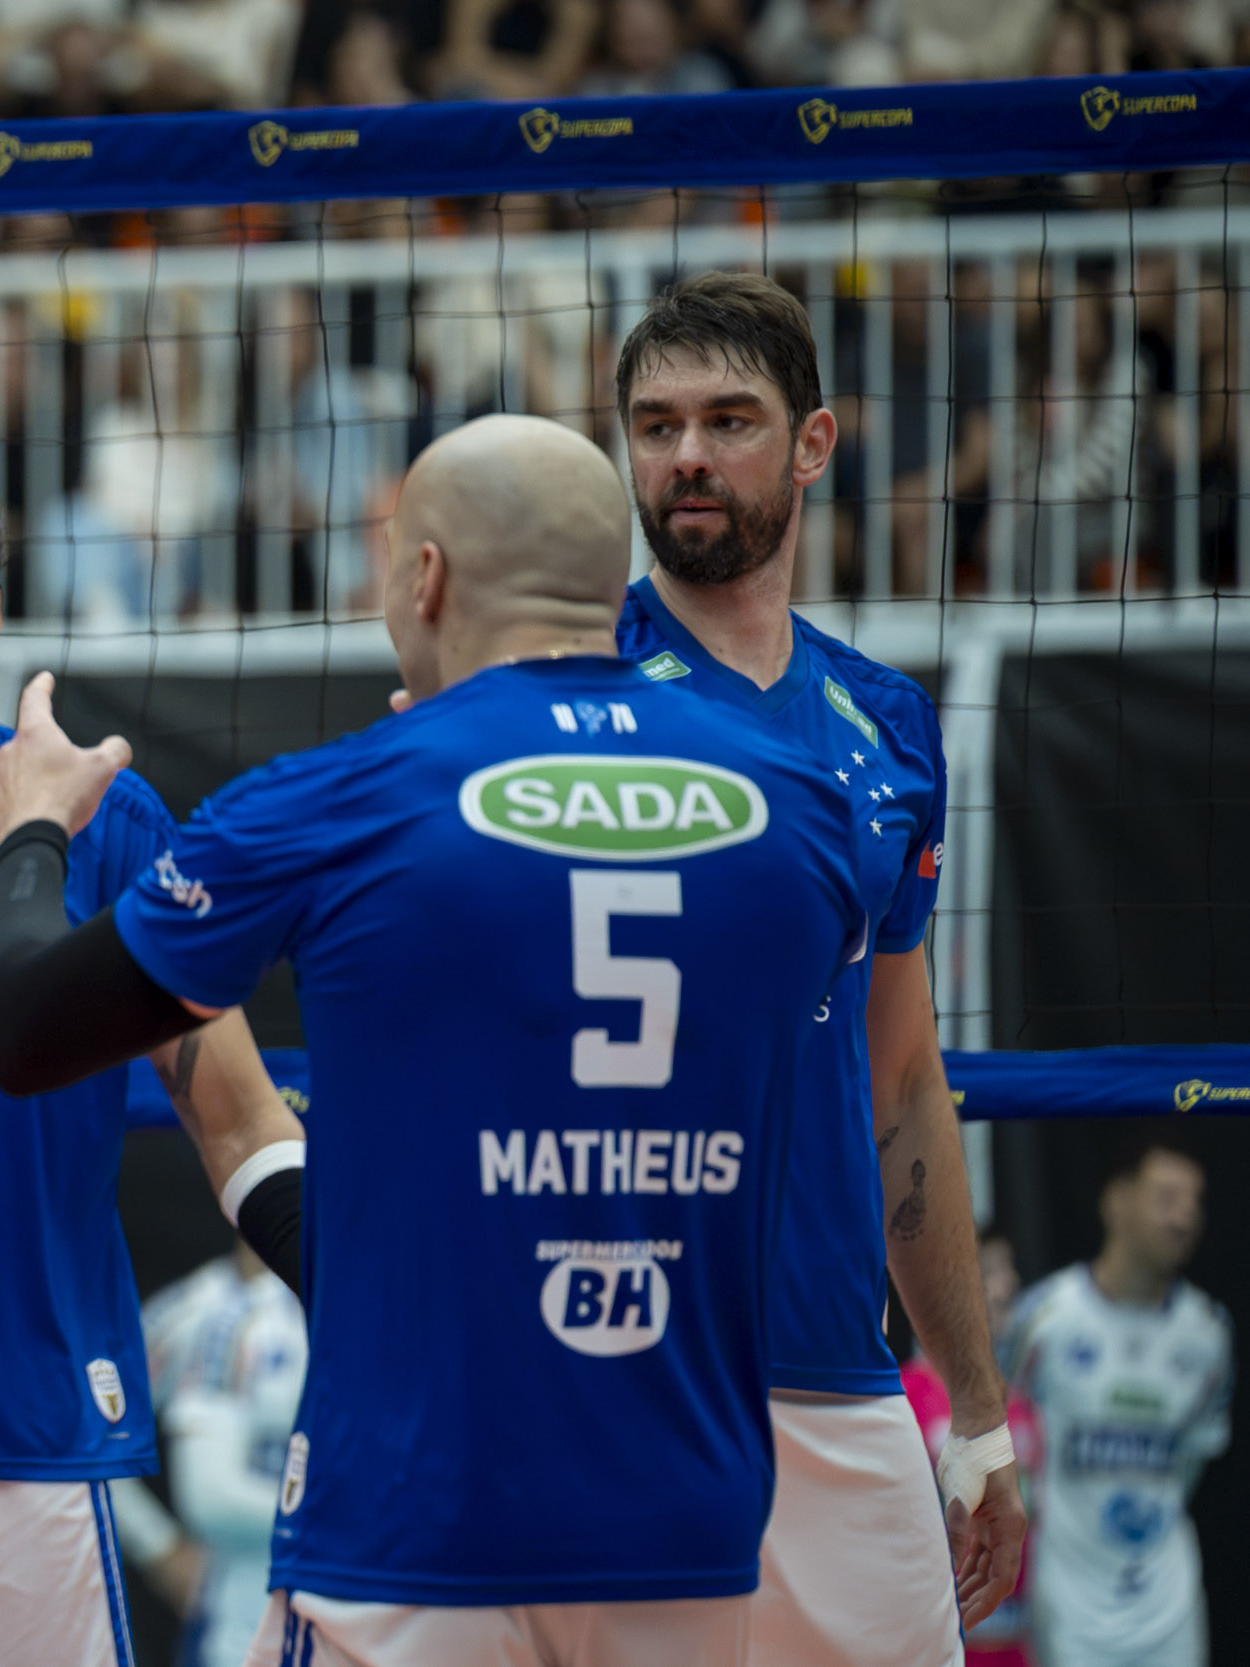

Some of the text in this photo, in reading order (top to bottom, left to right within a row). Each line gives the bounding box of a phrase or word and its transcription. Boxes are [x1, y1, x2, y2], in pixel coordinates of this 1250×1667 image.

[503, 778, 735, 832] SADA
[569, 868, 684, 1090] 5
[478, 1129, 745, 1196] MATHEUS
[562, 1267, 654, 1330] BH
